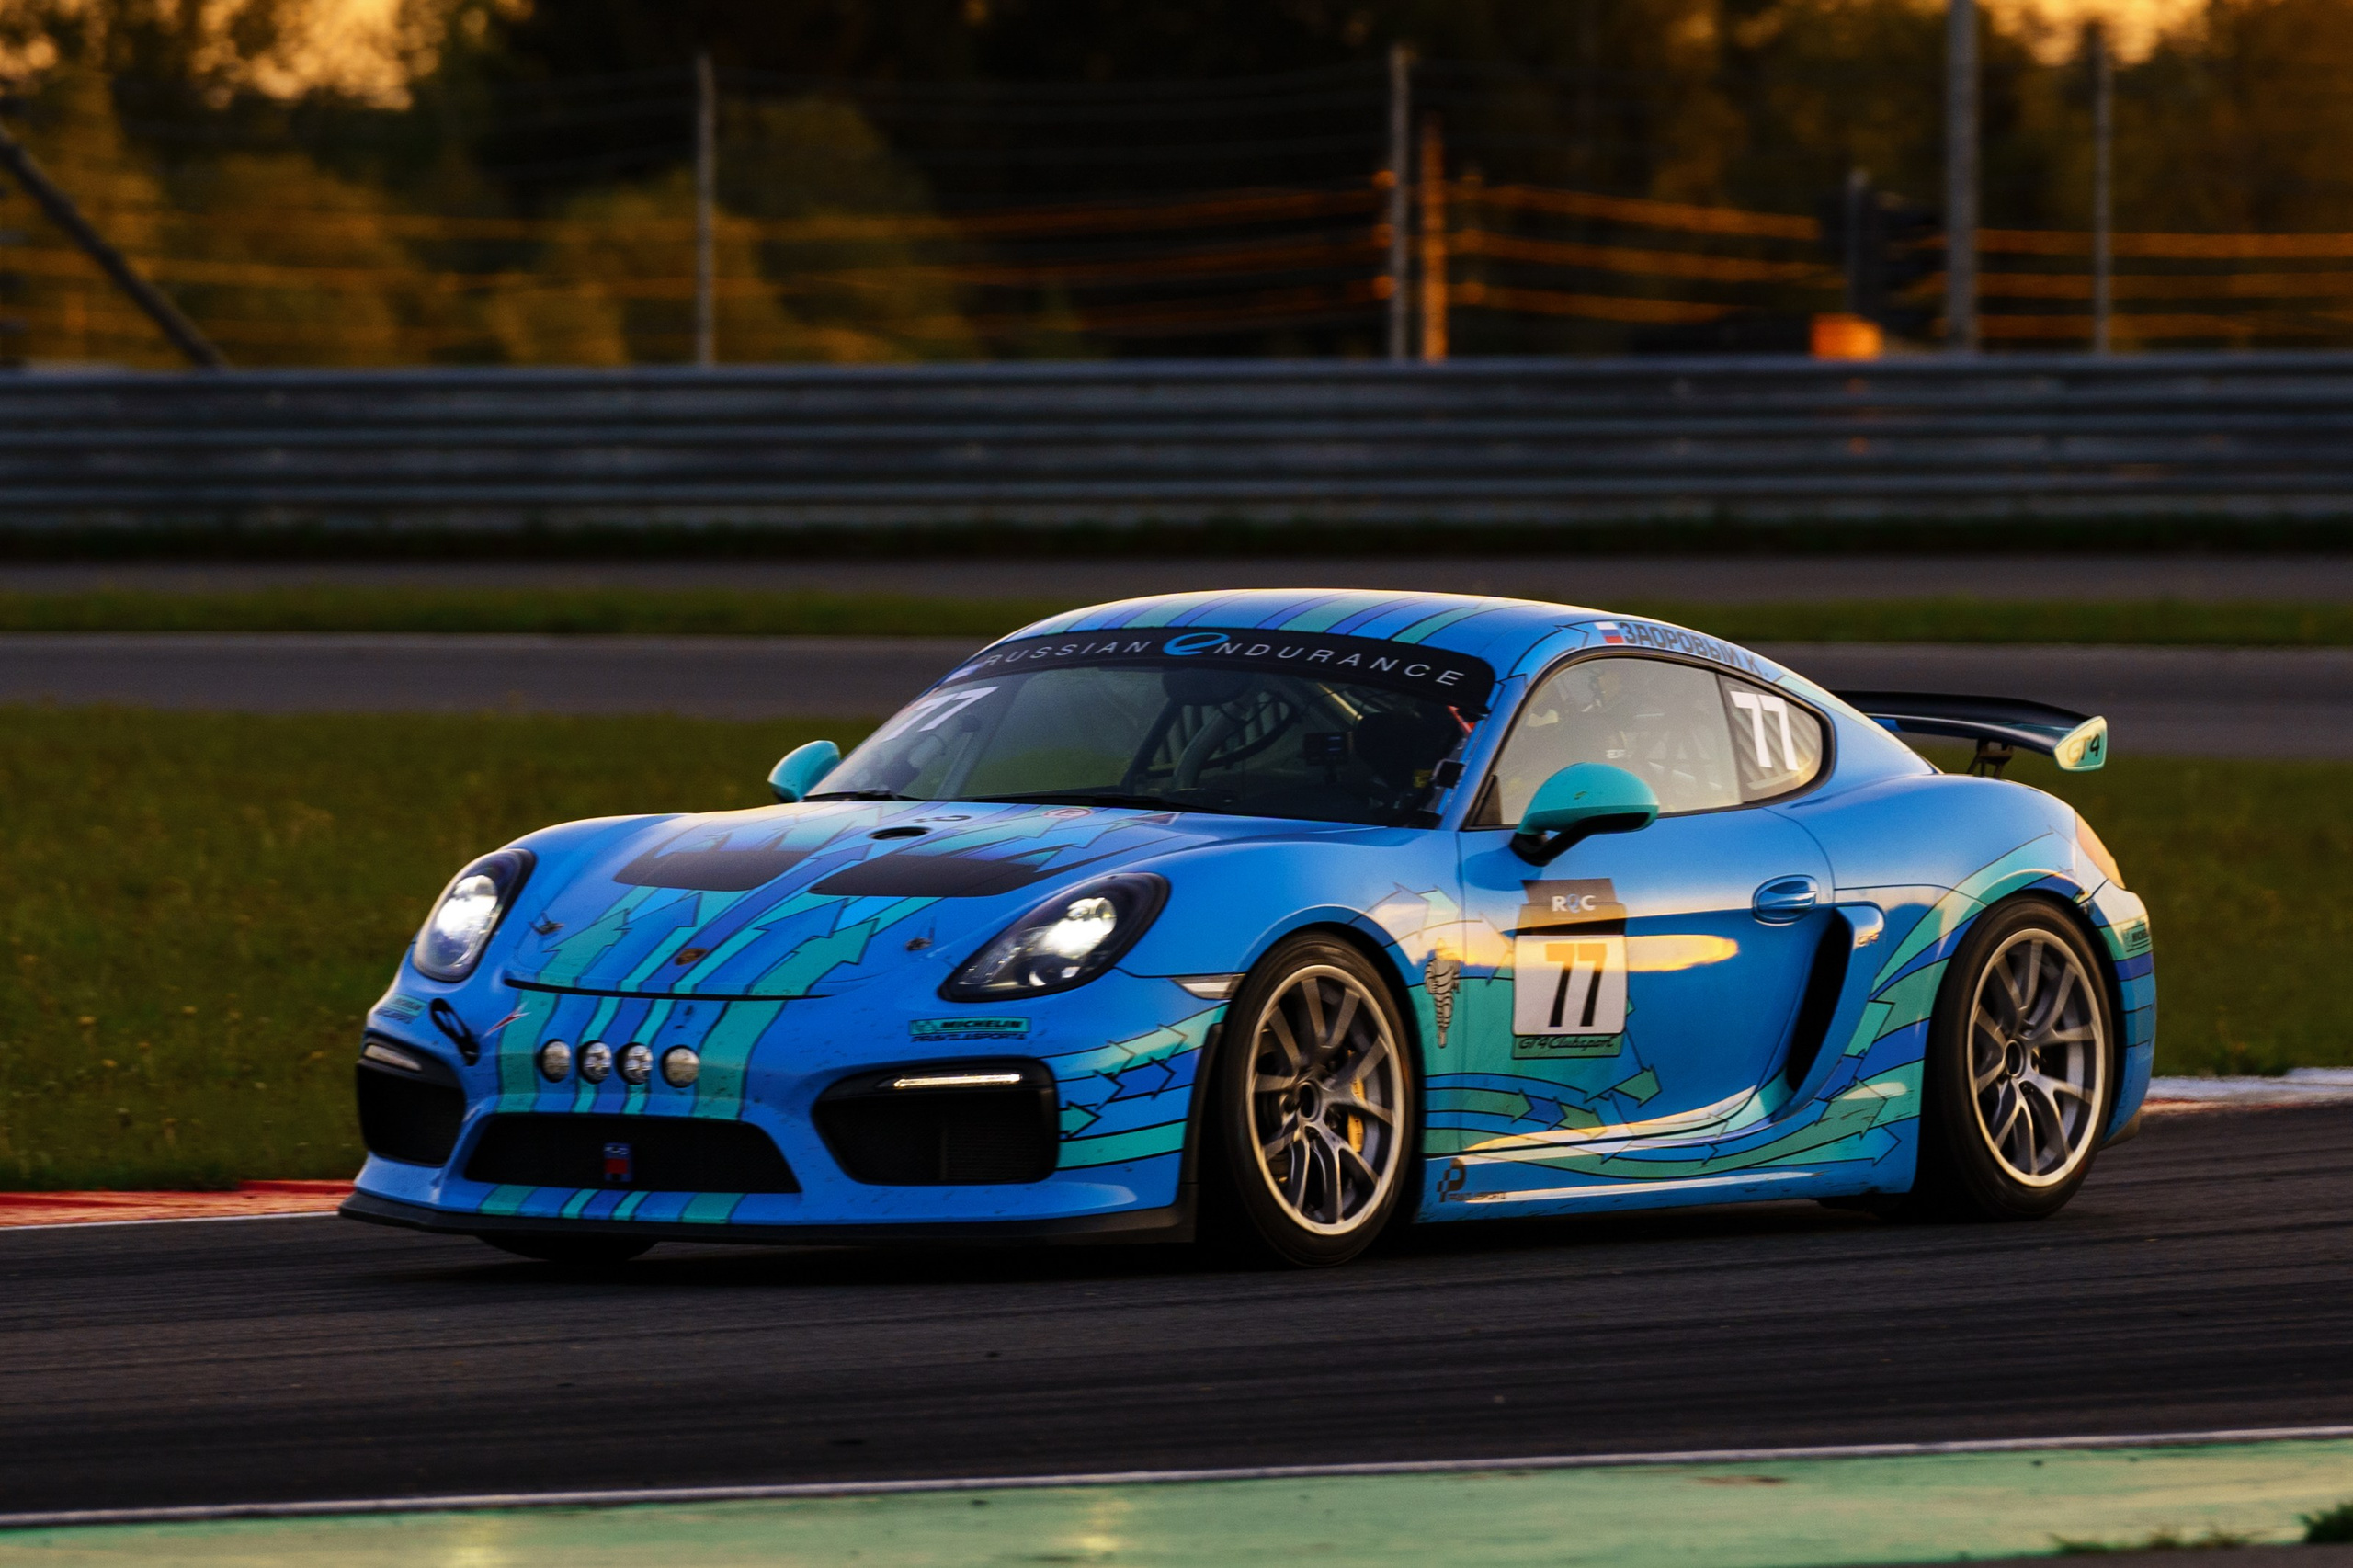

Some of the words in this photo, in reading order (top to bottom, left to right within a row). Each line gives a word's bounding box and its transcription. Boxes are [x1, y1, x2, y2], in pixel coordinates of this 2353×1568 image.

[984, 641, 1152, 666] RUSSIAN
[881, 686, 1000, 743] 77
[1730, 690, 1799, 771] 77
[1545, 943, 1607, 1028] 77
